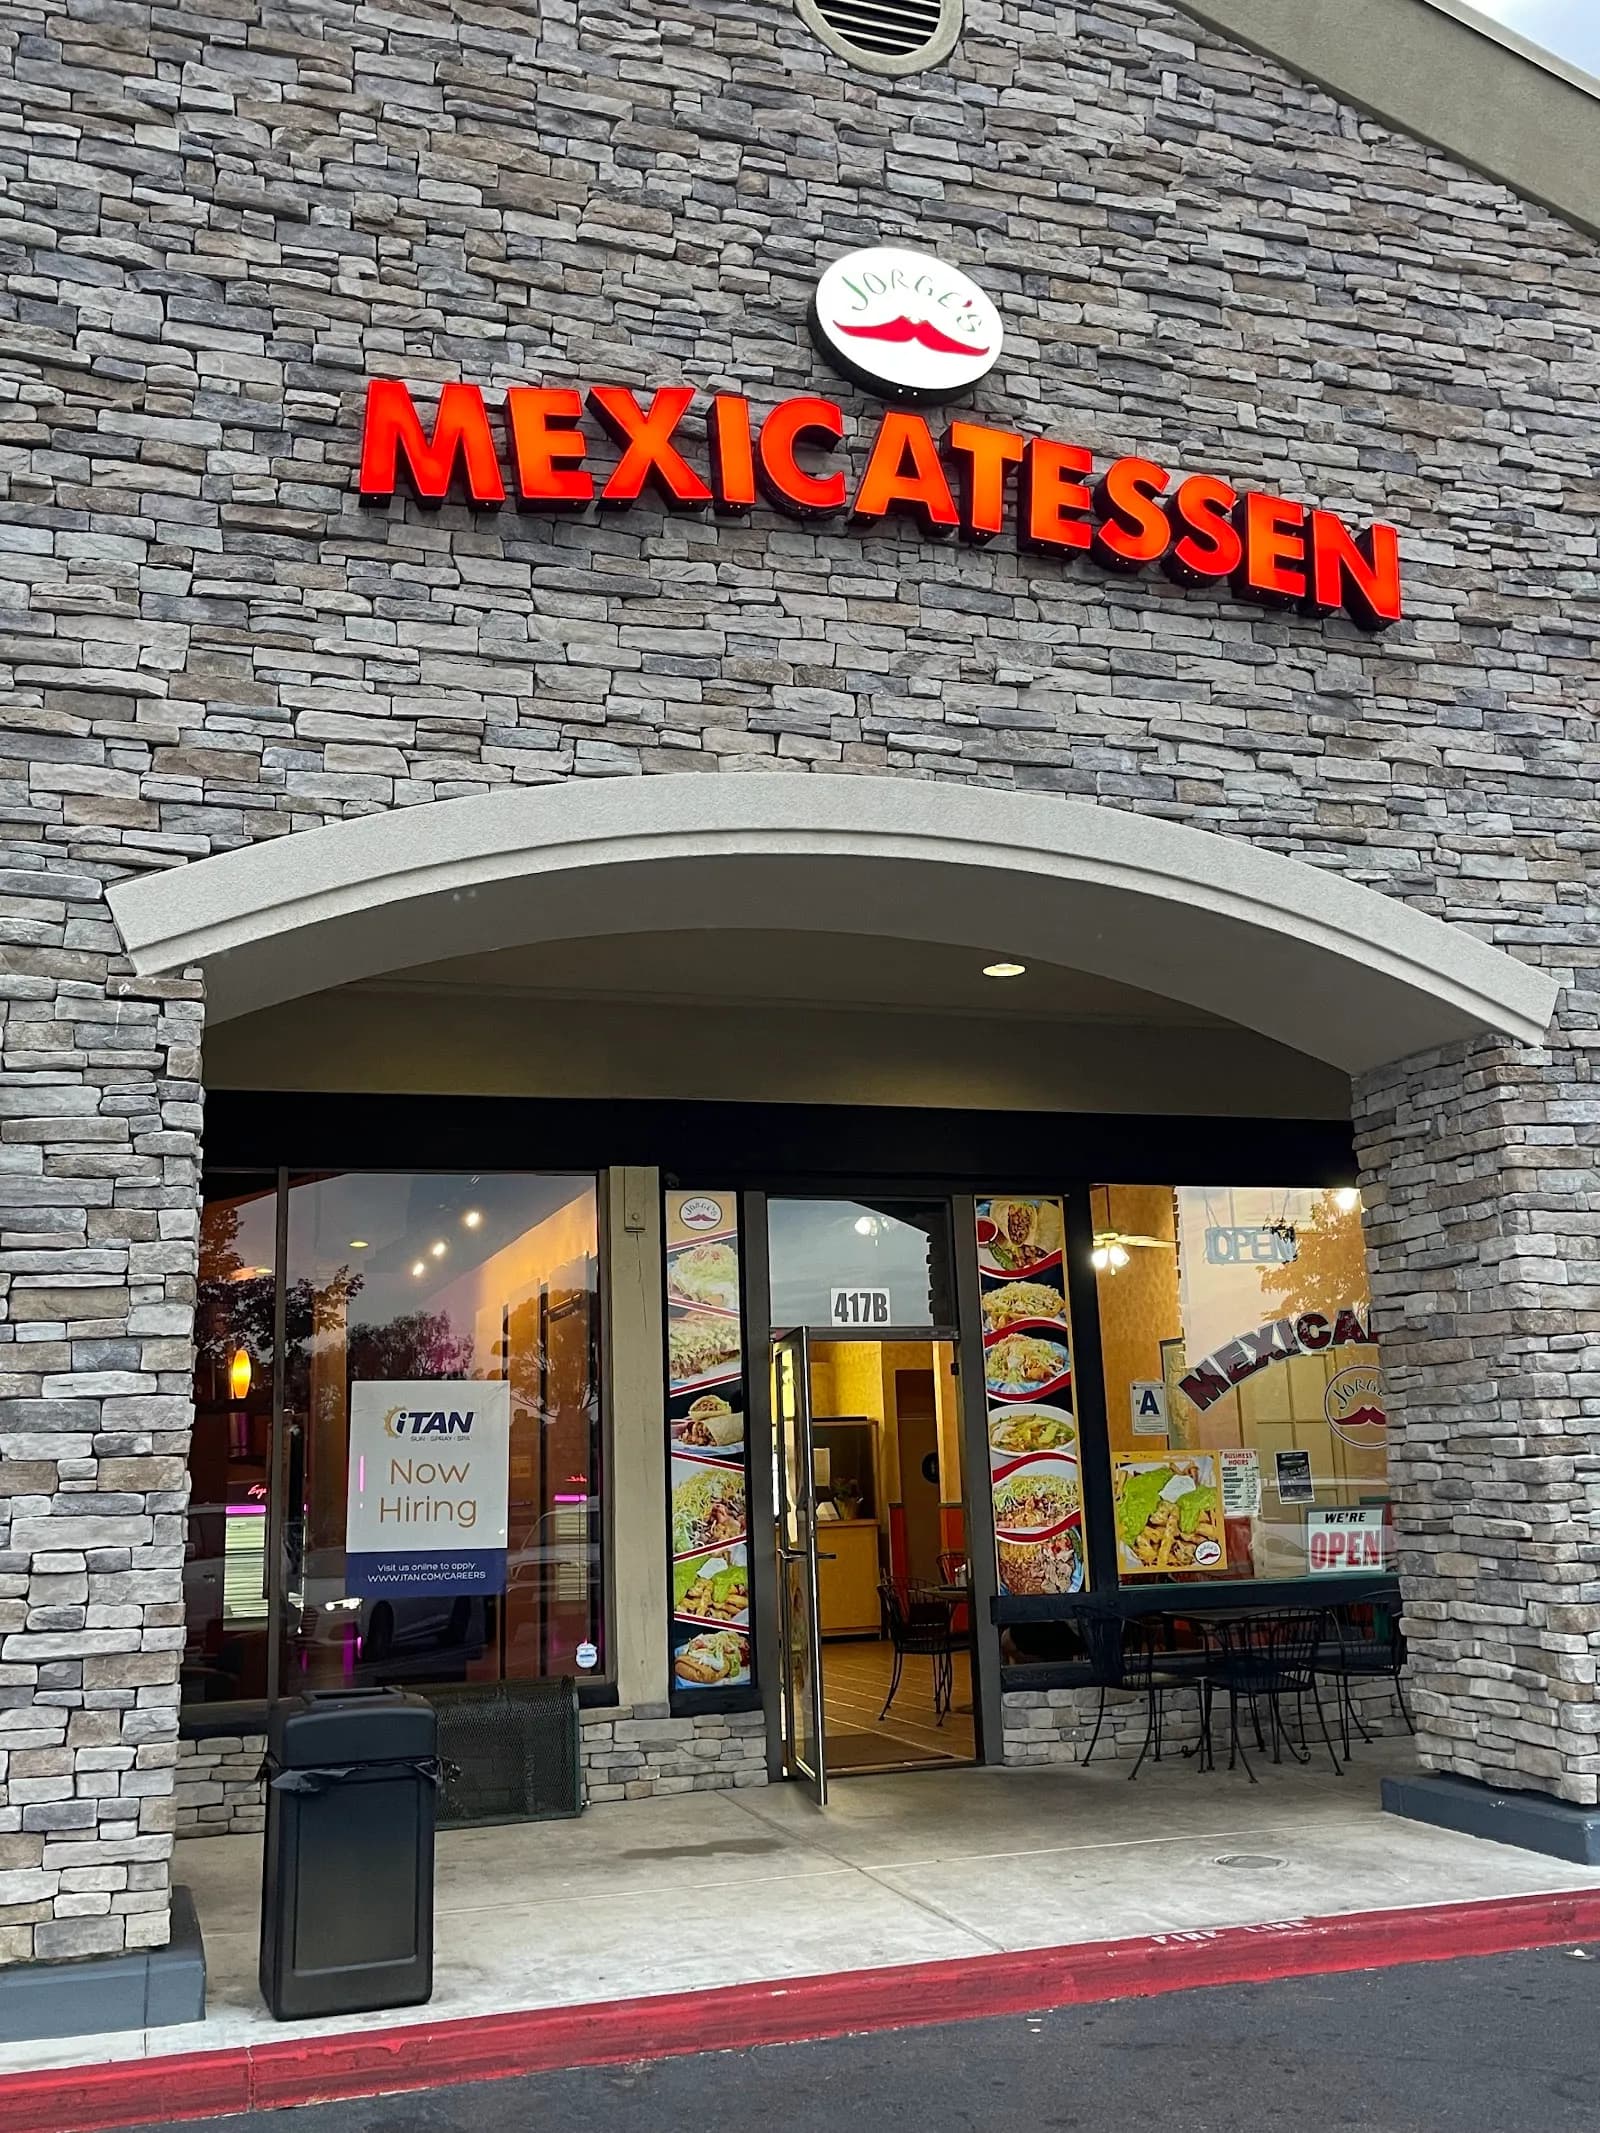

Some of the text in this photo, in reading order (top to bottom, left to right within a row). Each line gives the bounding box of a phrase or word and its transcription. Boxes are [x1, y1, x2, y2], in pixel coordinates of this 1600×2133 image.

[841, 268, 983, 333] JORGE'S
[359, 379, 1401, 630] MEXICATESSEN
[1212, 1230, 1297, 1262] OPEN
[834, 1292, 888, 1322] 417B
[1178, 1309, 1378, 1411] MEXICA
[1139, 1390, 1160, 1415] A
[396, 1411, 475, 1434] iTAN
[391, 1459, 470, 1484] Now
[380, 1496, 477, 1528] Hiring
[1325, 1512, 1366, 1524] WE'RE
[1311, 1530, 1380, 1570] OPEN
[377, 1563, 396, 1572] Visit
[411, 1562, 438, 1571] online
[440, 1562, 449, 1570] to
[451, 1561, 476, 1571] apply
[1151, 1931, 1225, 1944] FIRE
